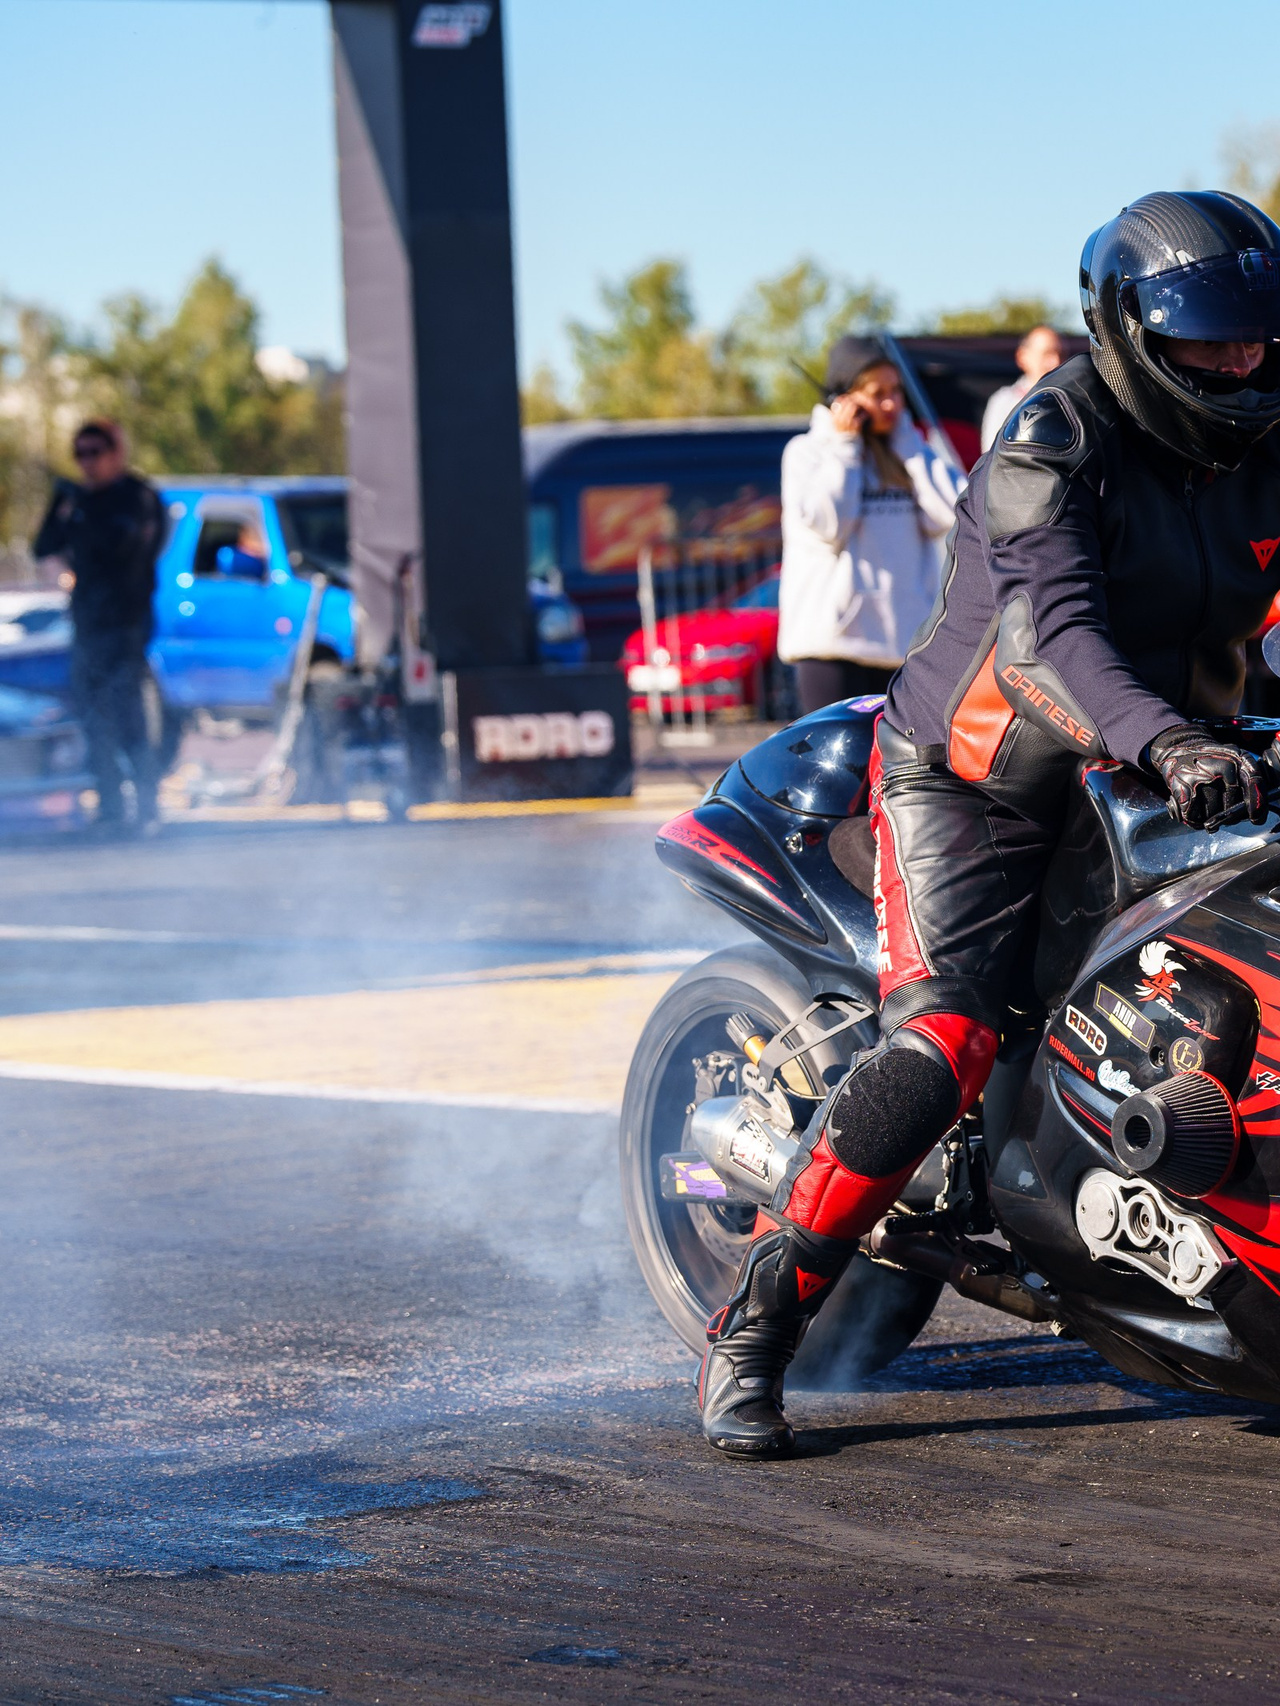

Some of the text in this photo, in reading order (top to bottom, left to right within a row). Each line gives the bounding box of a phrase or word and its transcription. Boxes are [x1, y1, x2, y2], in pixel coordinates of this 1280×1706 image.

[1000, 664, 1095, 747] DAINESE
[1068, 1010, 1105, 1048] RDRC
[1049, 1034, 1096, 1082] RIDERMALL.RU
